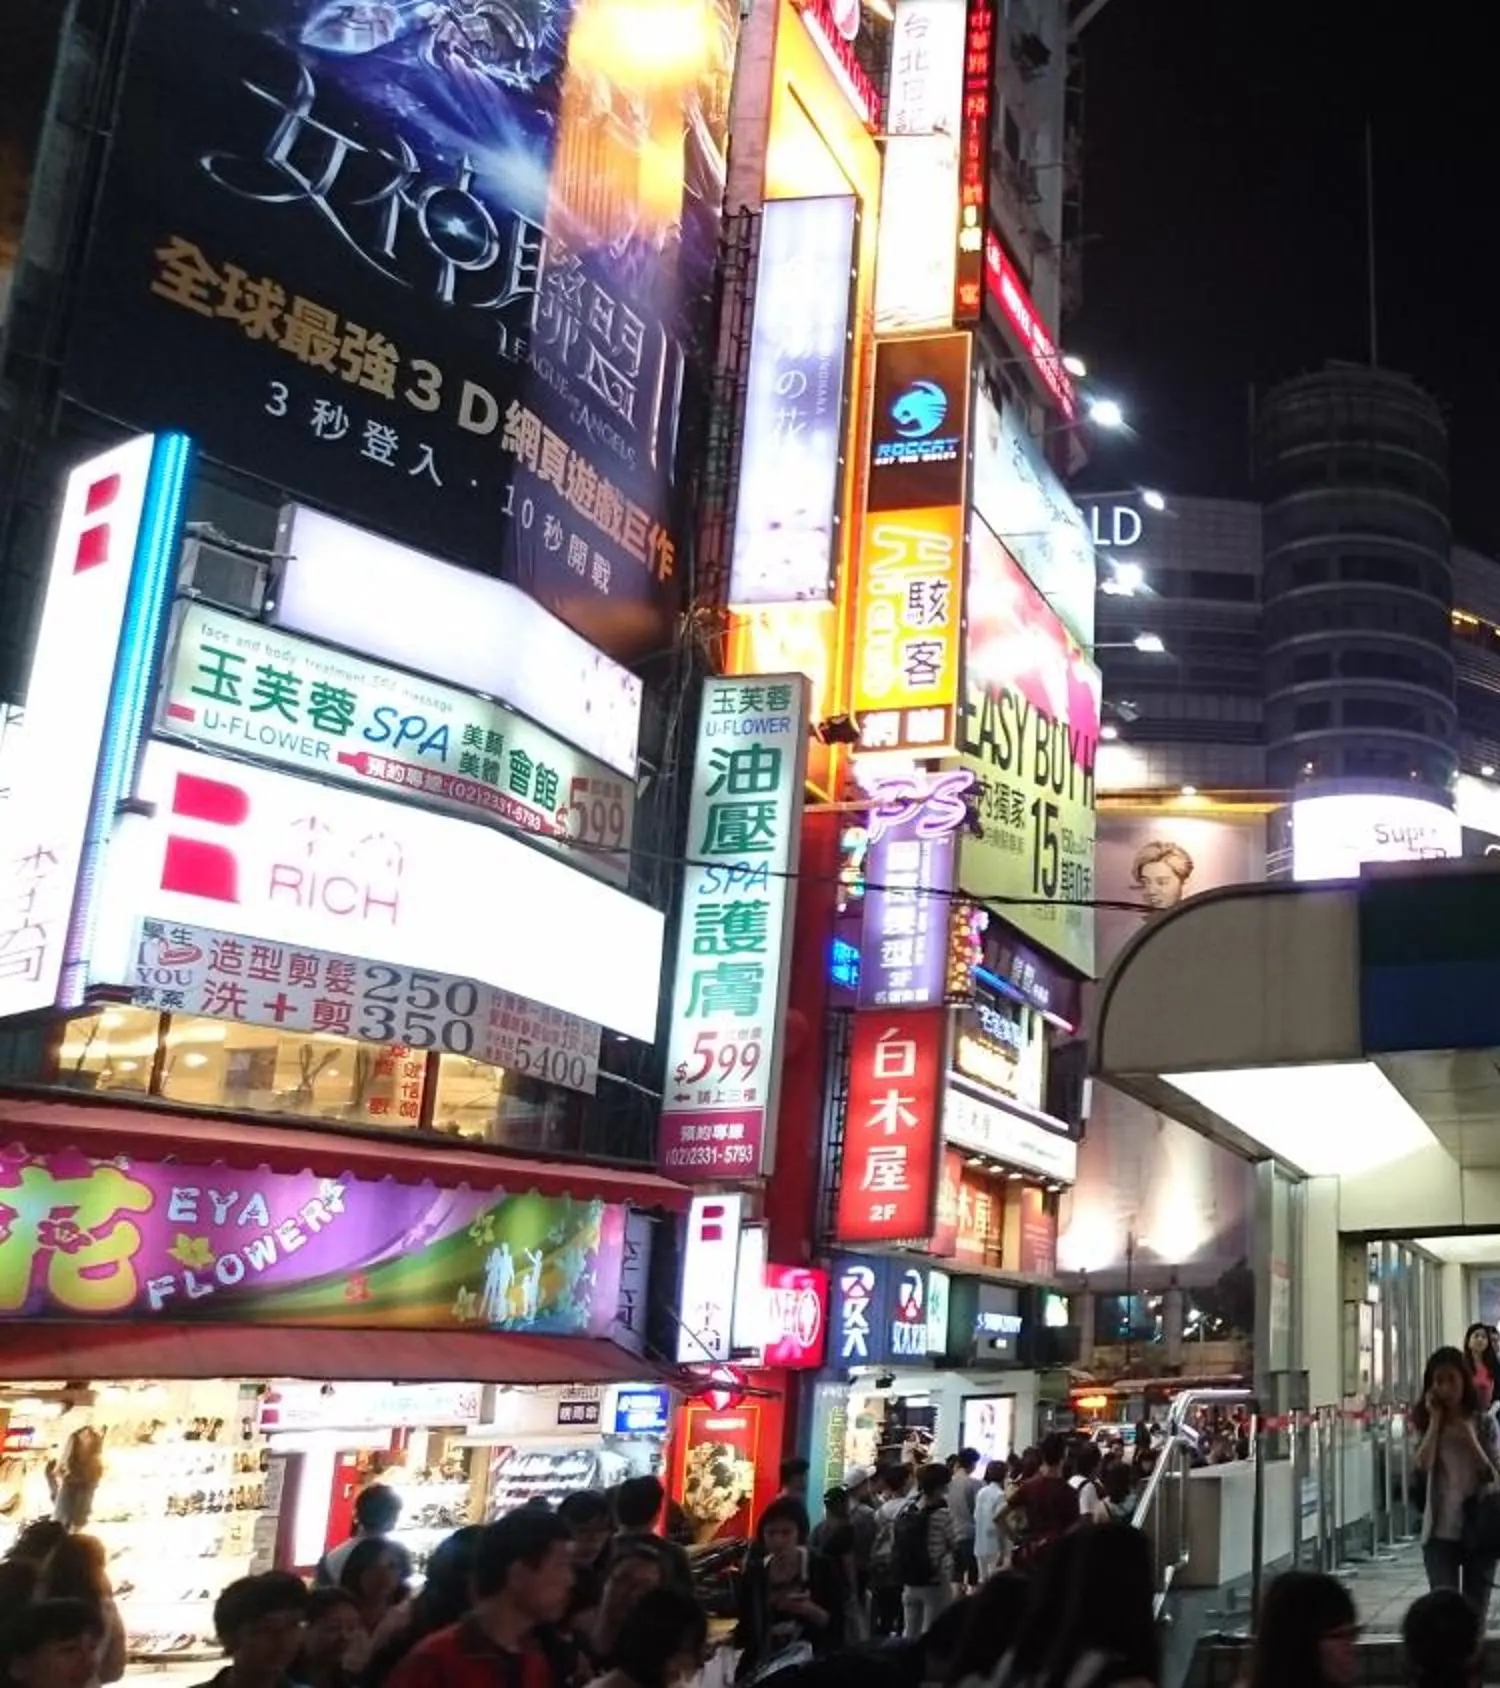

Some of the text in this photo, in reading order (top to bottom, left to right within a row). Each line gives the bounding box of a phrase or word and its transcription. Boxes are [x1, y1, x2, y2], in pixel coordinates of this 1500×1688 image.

[877, 438, 959, 457] ROCCAT
[191, 643, 450, 763] 玉芙蓉 SPA
[711, 685, 792, 715] 玉芙蓉
[203, 708, 331, 761] U-FLOWER
[706, 716, 791, 737] U-FLOWER
[269, 863, 400, 926] RICH
[699, 858, 770, 895] SPA
[136, 967, 193, 986] YOU
[362, 964, 478, 1018] 250
[358, 1004, 475, 1054] 350
[515, 1035, 587, 1090] 5400
[674, 1031, 762, 1086] $599
[861, 1027, 919, 1193] 白木屋
[168, 1186, 270, 1228] EYA
[868, 1203, 897, 1223] 2F
